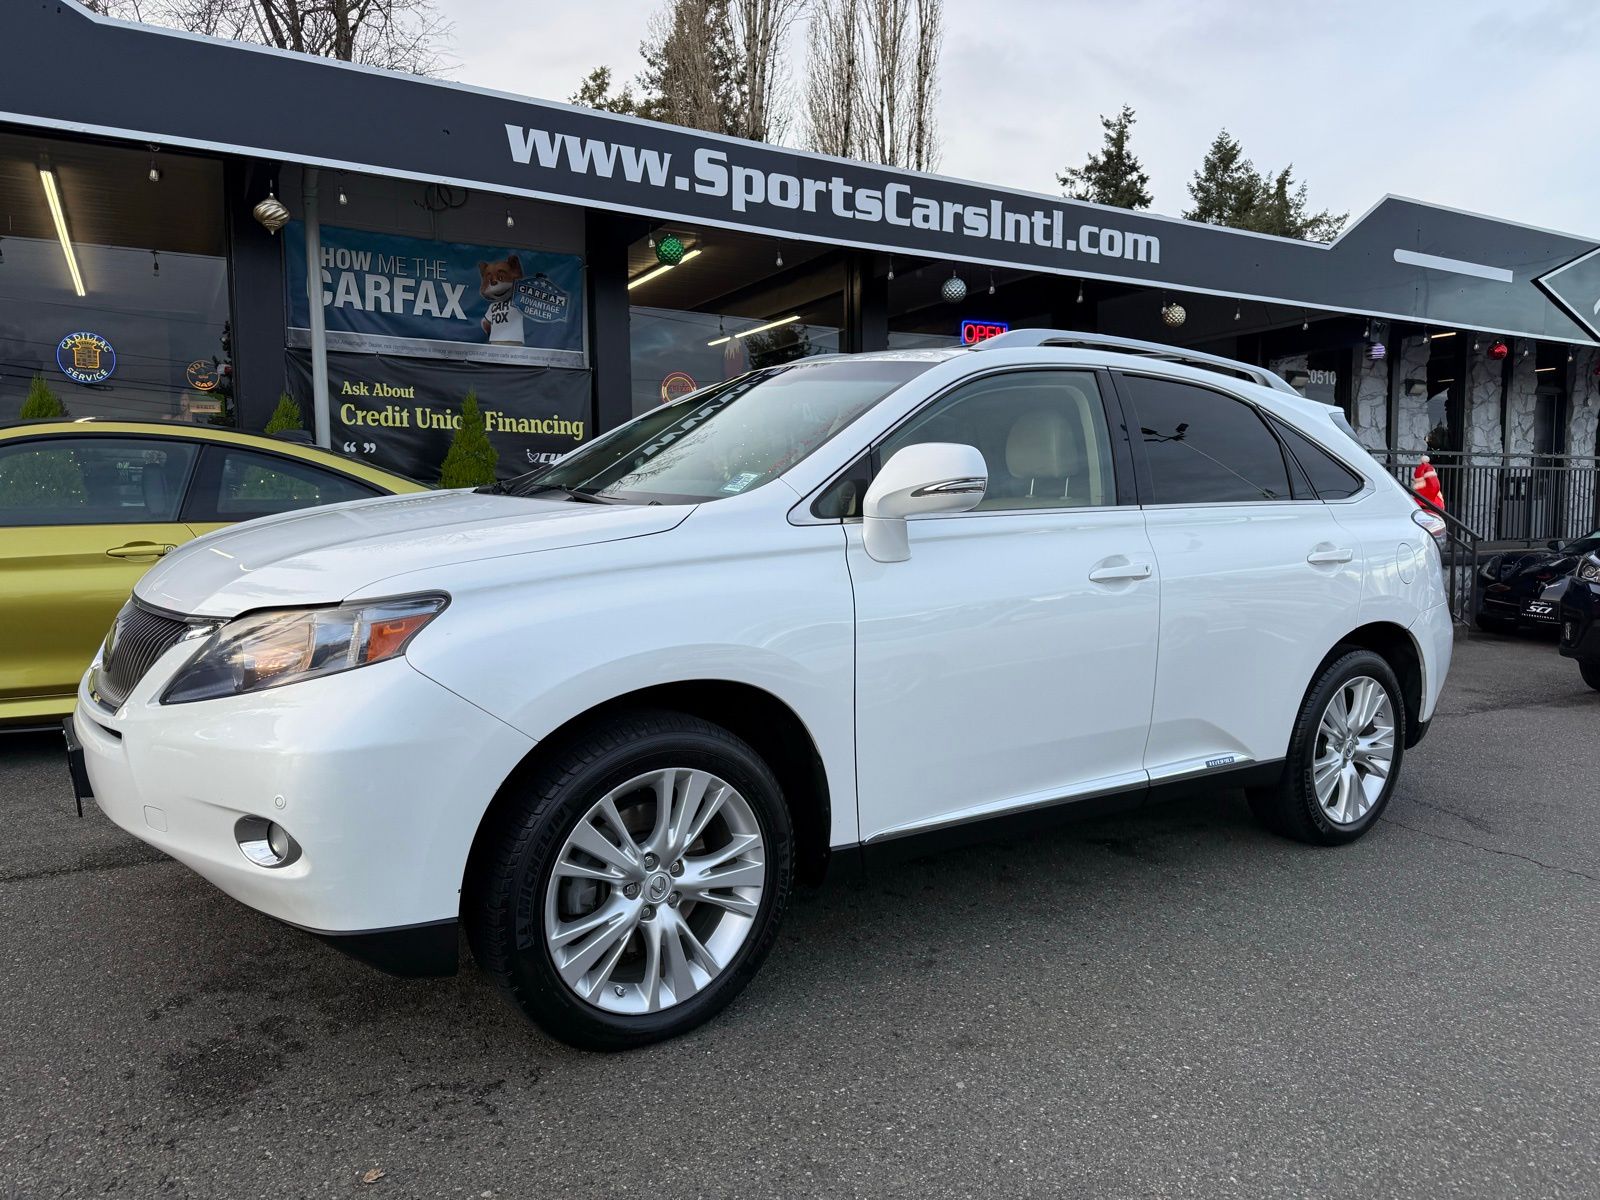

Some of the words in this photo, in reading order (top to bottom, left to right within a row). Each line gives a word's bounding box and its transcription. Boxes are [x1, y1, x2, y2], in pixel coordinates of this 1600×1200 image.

[504, 123, 1161, 264] www.SportsCarsIntl.com
[320, 247, 371, 271] HOW
[378, 254, 406, 274] ME
[412, 258, 447, 280] THE
[519, 285, 566, 307] CARFAX
[520, 295, 560, 314] ADVANTAGE
[491, 301, 509, 313] CAR
[524, 305, 552, 320] DEALER
[491, 312, 508, 325] FOX
[61, 333, 112, 353] CADILLAC
[66, 367, 108, 382] SERVICE
[341, 381, 369, 396] Ask
[372, 382, 415, 399] About
[340, 403, 410, 428] Credit
[416, 408, 462, 430] Unio
[485, 411, 584, 441] Financing
[539, 452, 568, 464] CU
